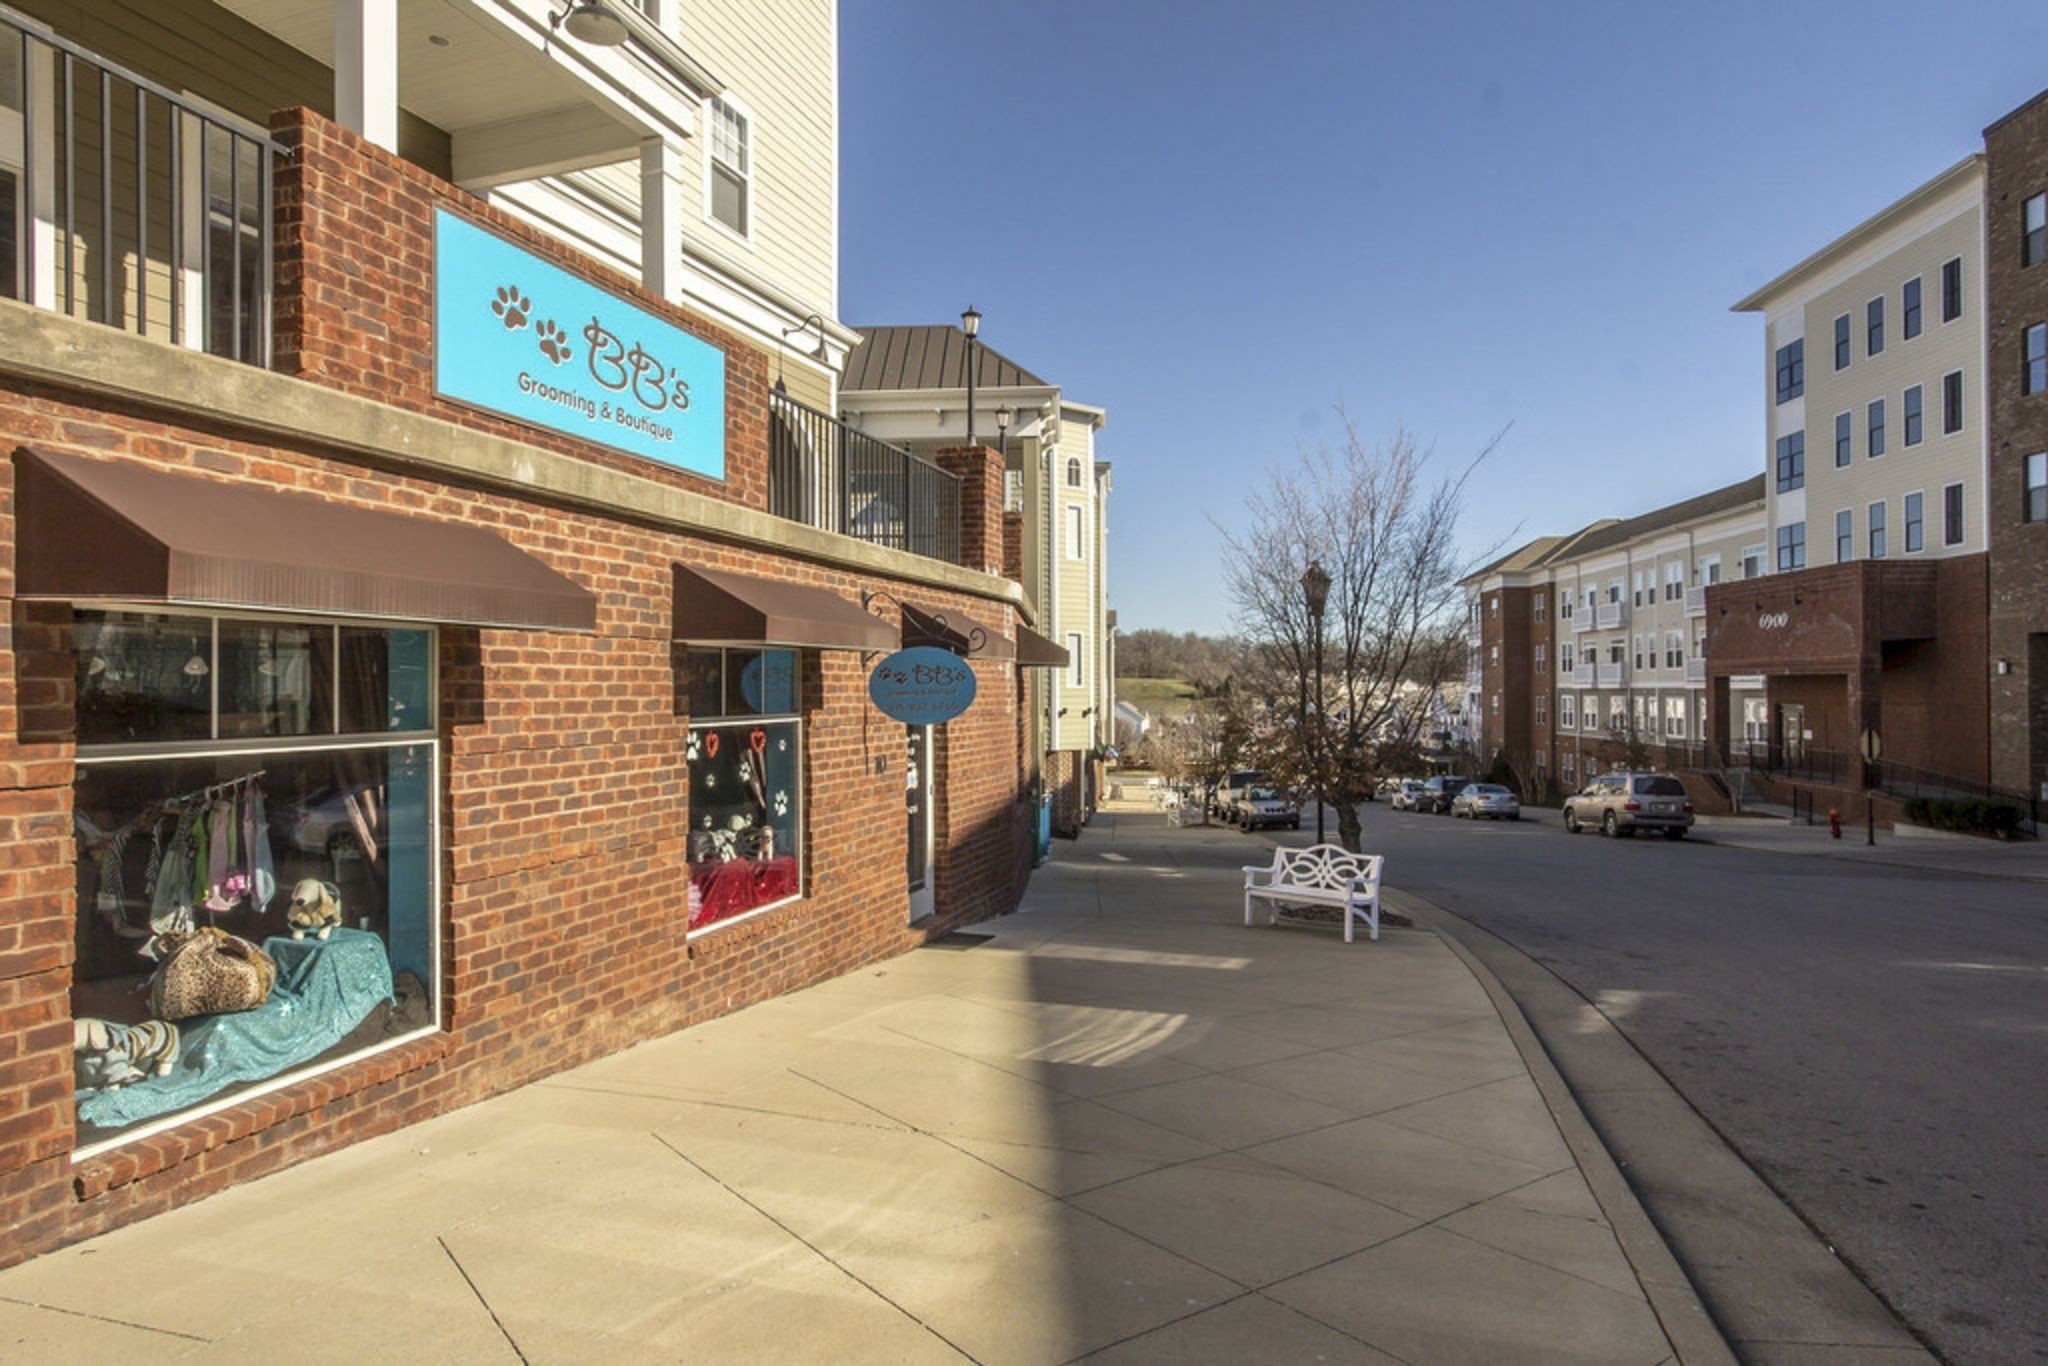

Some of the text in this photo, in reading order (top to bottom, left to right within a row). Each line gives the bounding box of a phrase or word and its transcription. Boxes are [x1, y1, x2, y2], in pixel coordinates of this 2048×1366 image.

[584, 316, 690, 410] BB's
[518, 372, 673, 441] Grooming & Boutique
[912, 664, 965, 686] BB's
